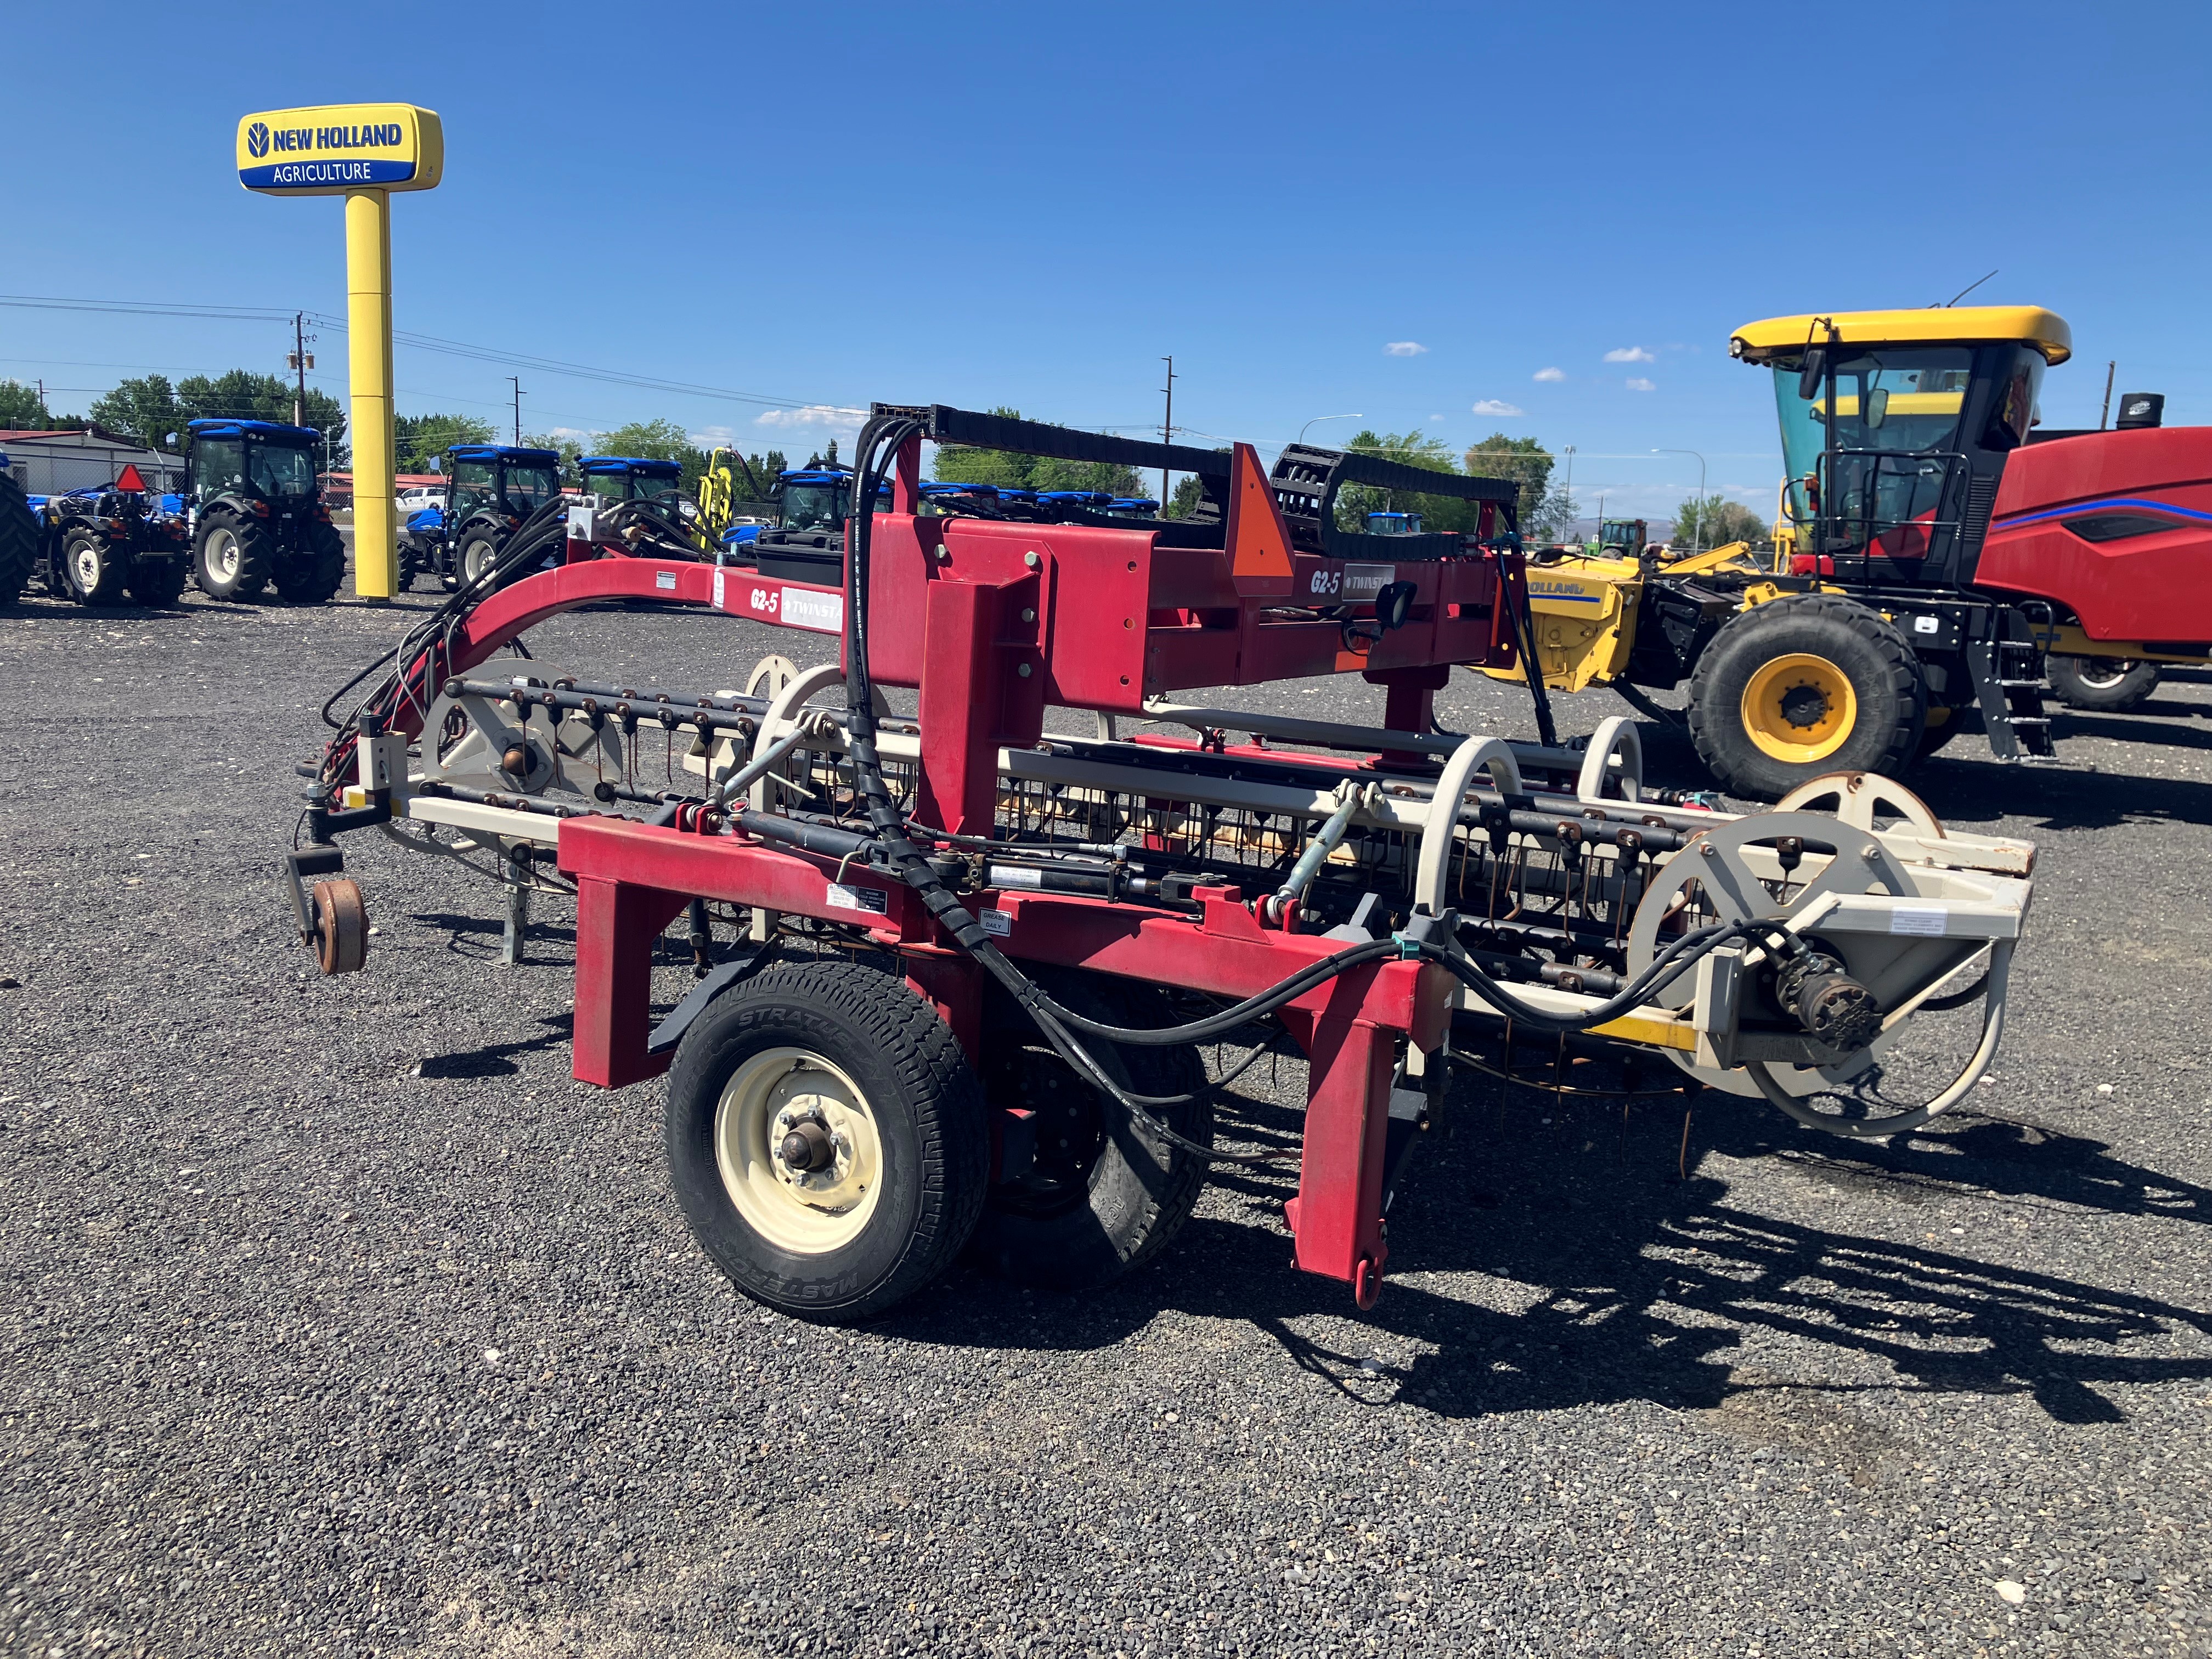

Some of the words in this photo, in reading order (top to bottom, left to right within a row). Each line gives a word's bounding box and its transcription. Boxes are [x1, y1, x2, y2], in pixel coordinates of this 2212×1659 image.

[274, 127, 313, 151] NEW
[317, 123, 402, 148] HOLLAND
[274, 162, 371, 182] AGRICULTURE
[1311, 570, 1341, 595] G2-5
[1352, 576, 1392, 589] TWINSTA
[1528, 582, 1585, 595] OLLAND
[751, 588, 779, 613] G2-5
[793, 601, 843, 619] TWINSTA
[834, 884, 856, 893] CAUTION
[983, 912, 1005, 921] GREASE
[1121, 1098, 1130, 1106] R17
[713, 1242, 857, 1300] MASTERCR
